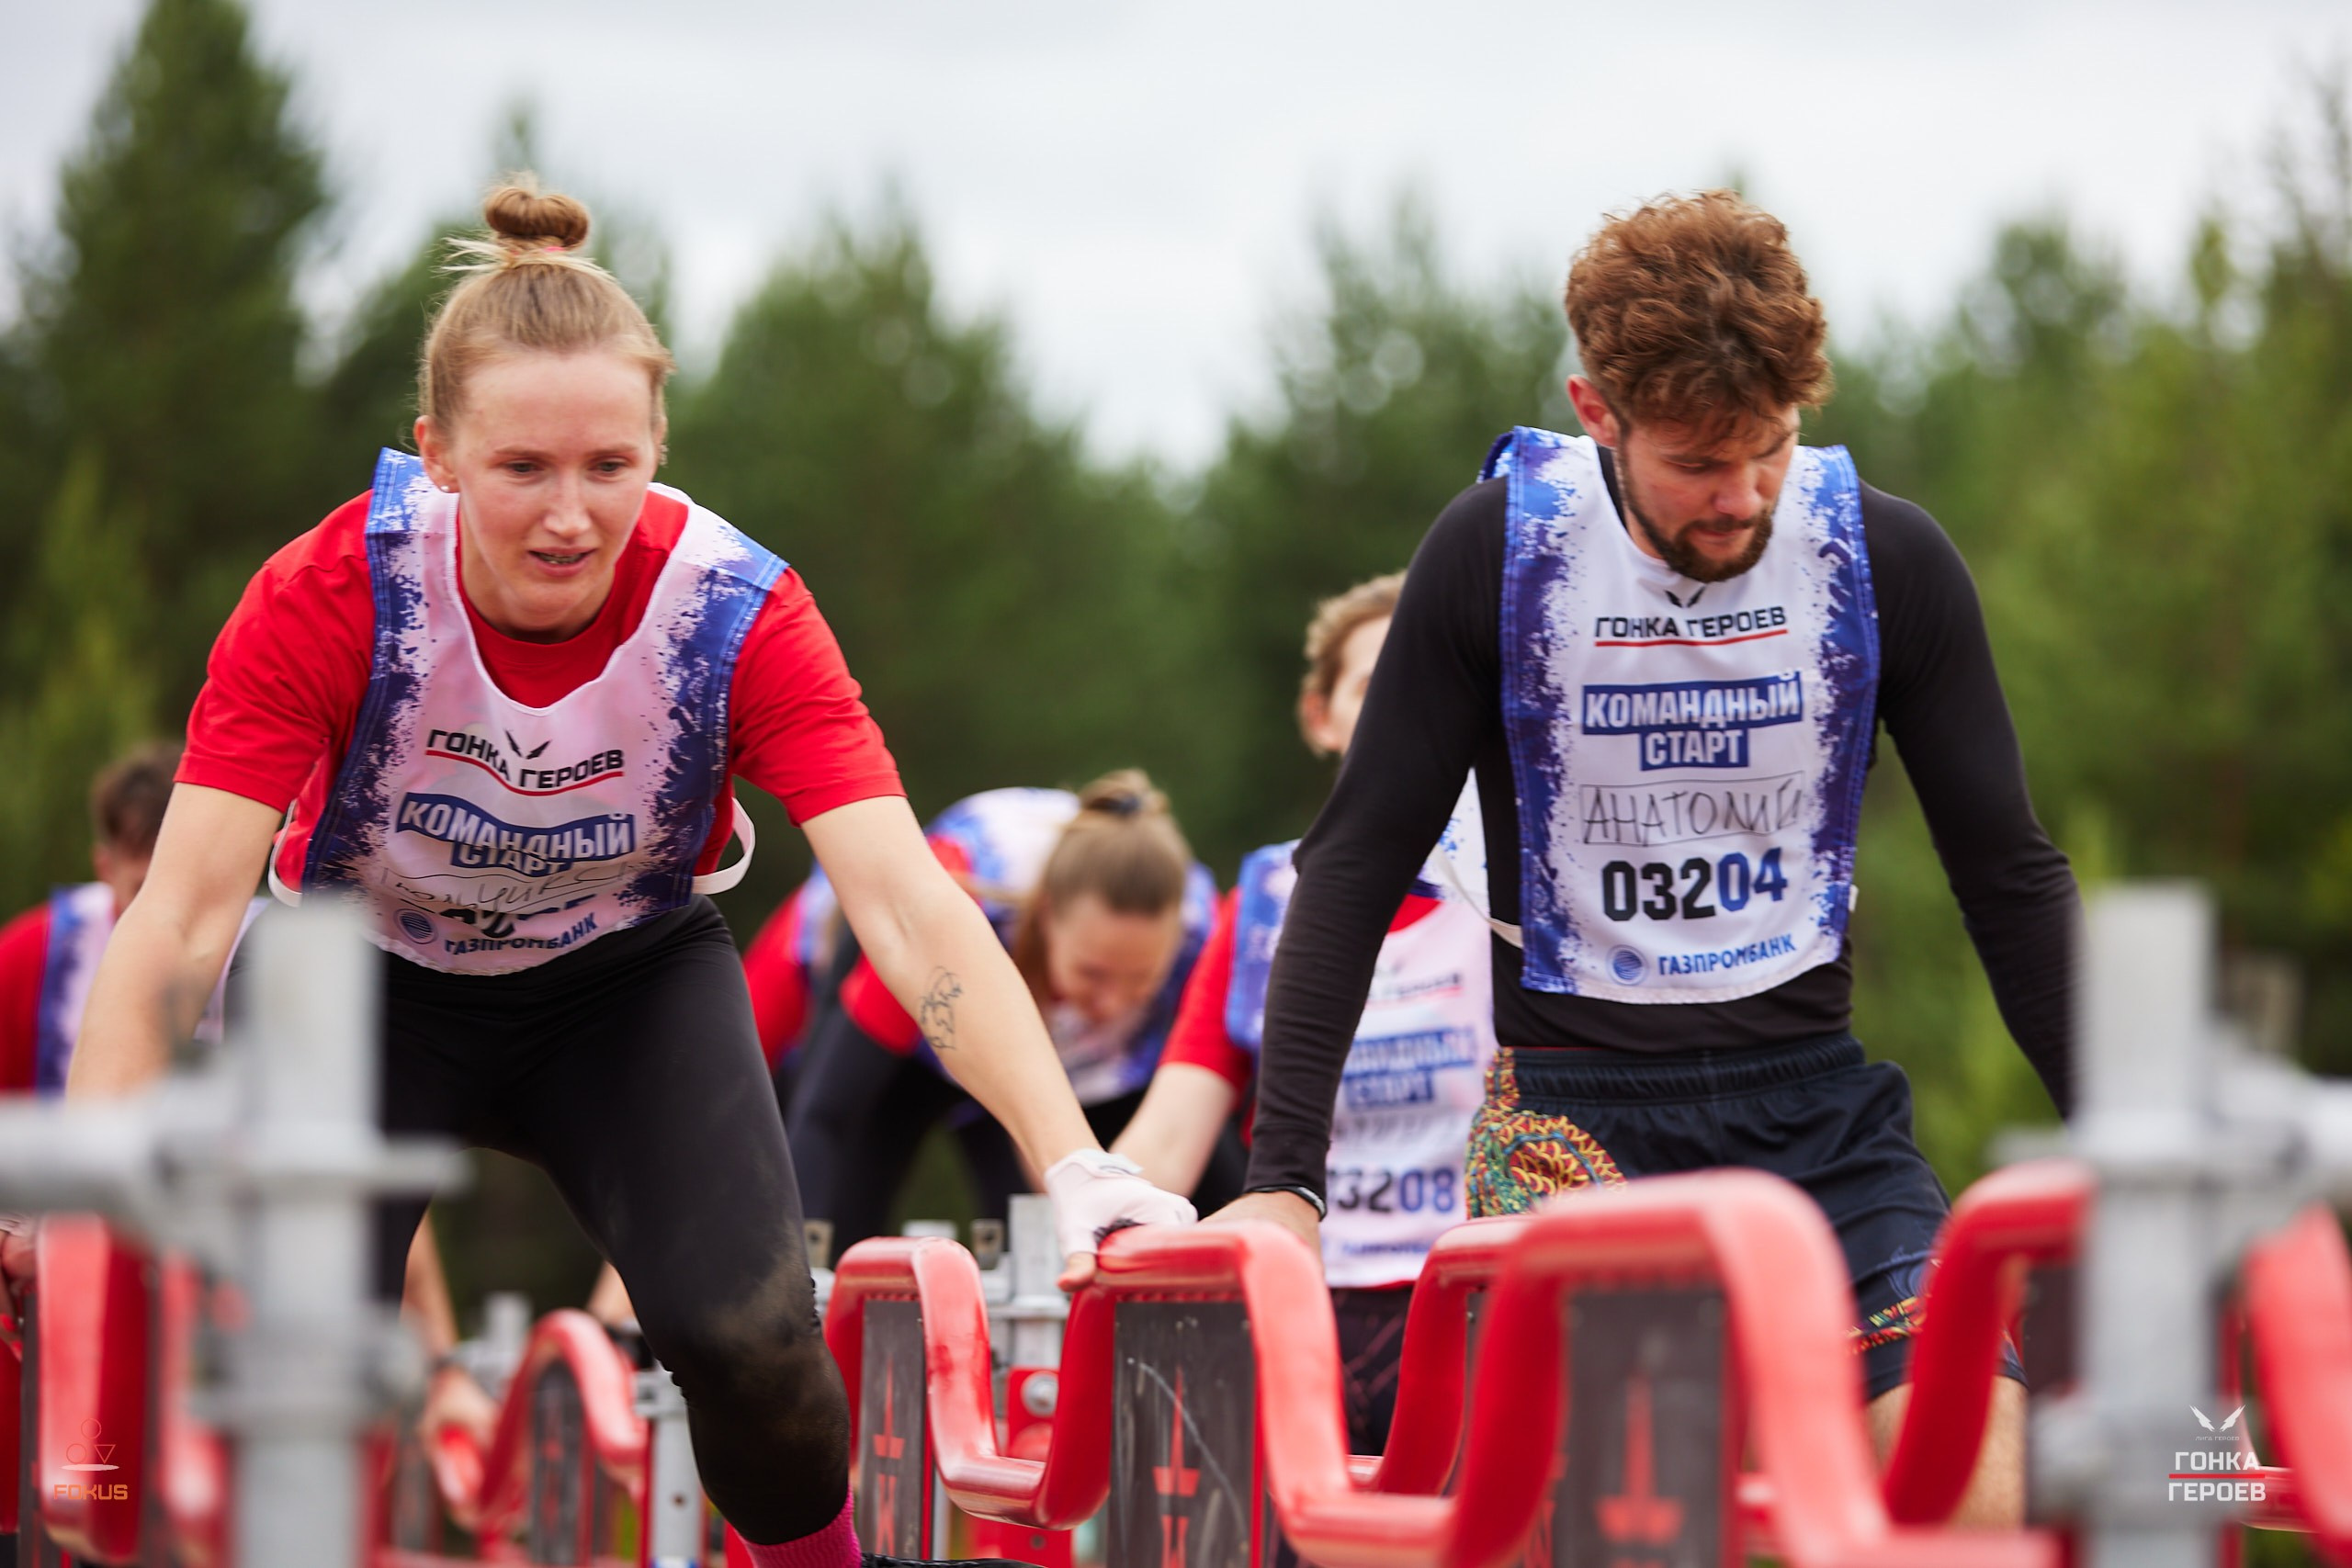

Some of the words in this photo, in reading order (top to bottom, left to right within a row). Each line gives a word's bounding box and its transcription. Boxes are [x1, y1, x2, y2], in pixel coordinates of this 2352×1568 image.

[1595, 616, 1679, 638] ГОНКА
[1686, 605, 1787, 638] ГЕРОЕВ
[1585, 671, 1801, 729] КОМАНДНЫЙ
[426, 728, 510, 782] ГОНКА
[519, 749, 625, 789] ГЕРОЕВ
[1645, 729, 1744, 766] СТАРТ
[401, 800, 633, 861] КОМАНДНЫЙ
[1601, 847, 1789, 922] 03204
[445, 911, 599, 955] ГАЗПРОМБАНК
[1657, 932, 1797, 976] ГАЗПРОМБАНК
[1329, 1167, 1456, 1213] 3208
